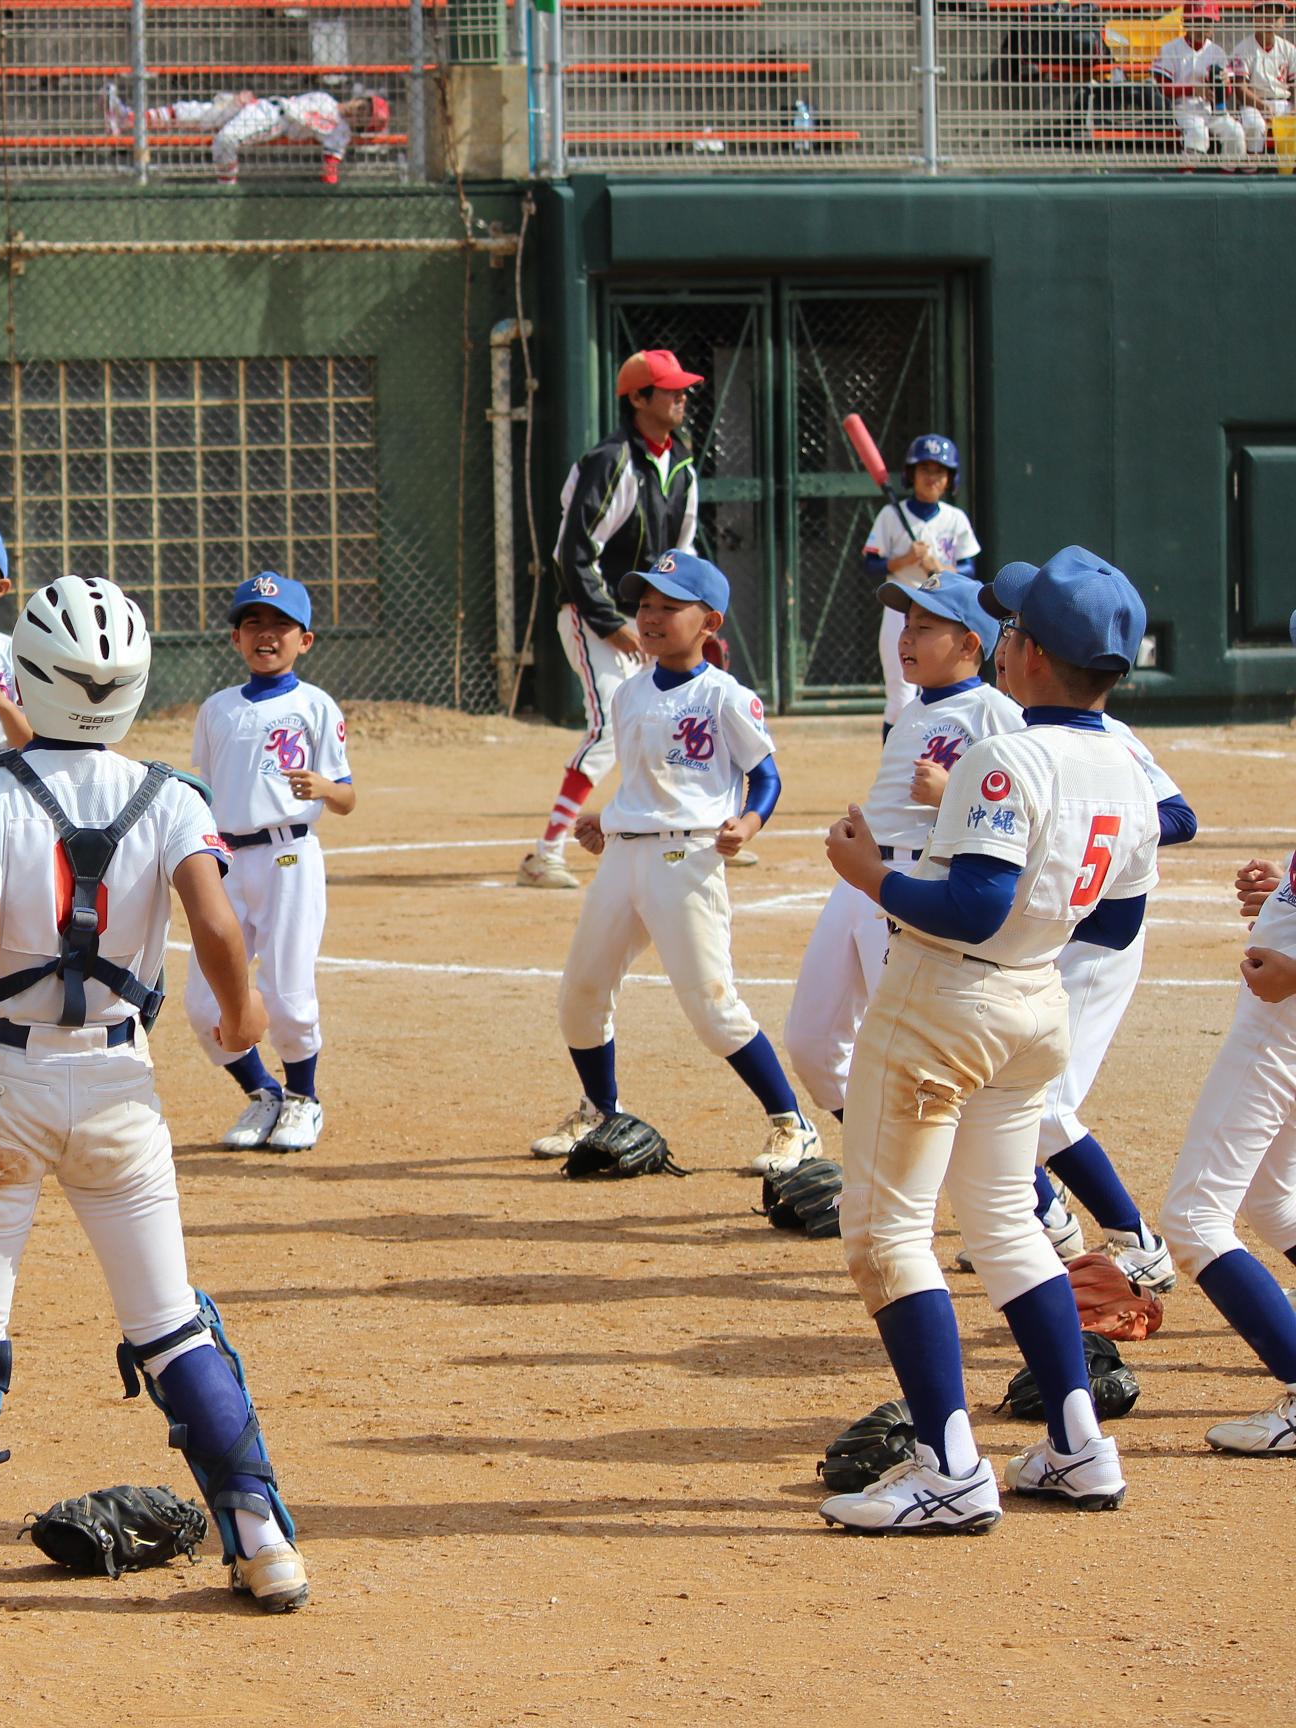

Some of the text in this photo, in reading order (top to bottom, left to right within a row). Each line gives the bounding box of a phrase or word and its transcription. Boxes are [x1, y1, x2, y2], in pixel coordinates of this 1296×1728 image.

[251, 576, 279, 597] MD
[264, 729, 305, 770] MD
[672, 717, 714, 761] MD
[921, 724, 951, 741] MIYAGI
[1069, 815, 1121, 907] 5
